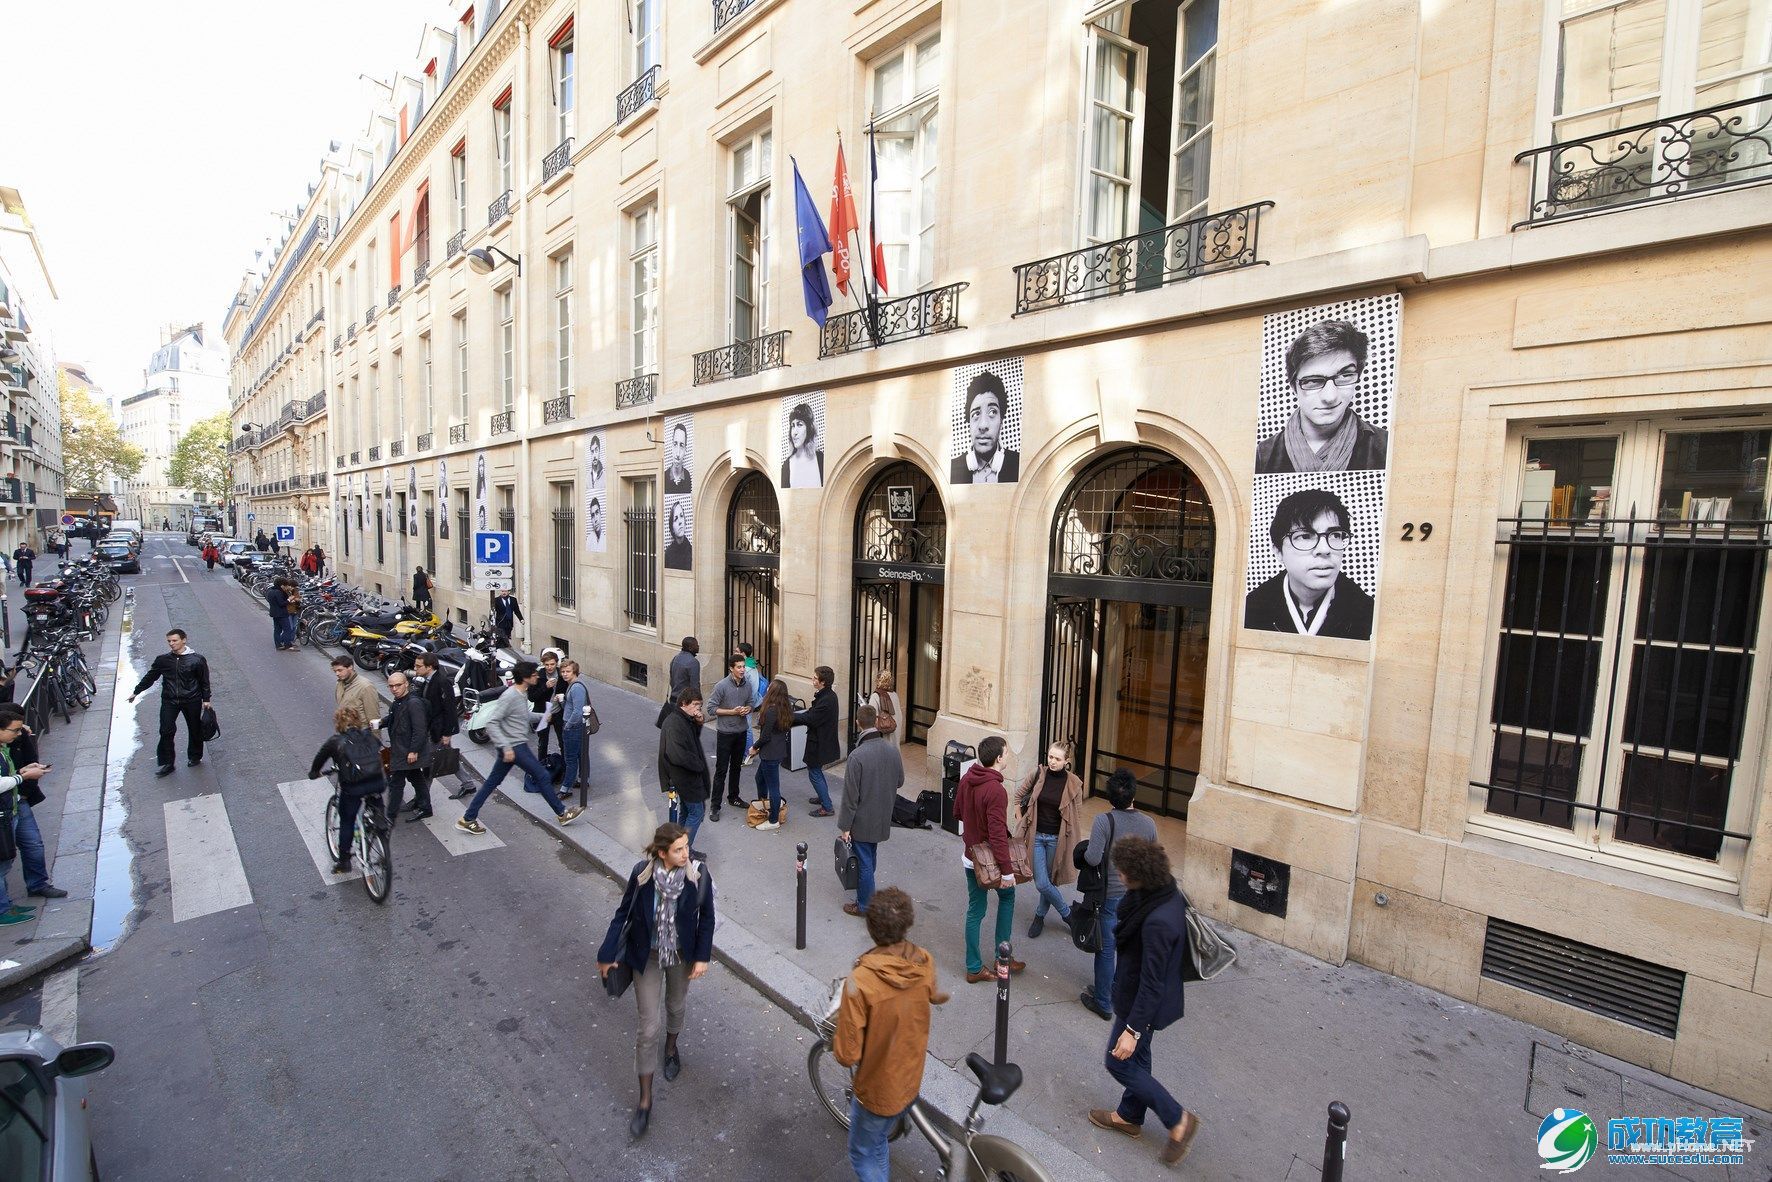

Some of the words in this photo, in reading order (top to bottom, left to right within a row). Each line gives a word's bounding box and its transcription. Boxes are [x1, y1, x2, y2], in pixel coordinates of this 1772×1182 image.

[281, 528, 291, 539] P
[1401, 522, 1433, 541] 29
[485, 538, 501, 559] P
[878, 567, 923, 581] SciencesPo.
